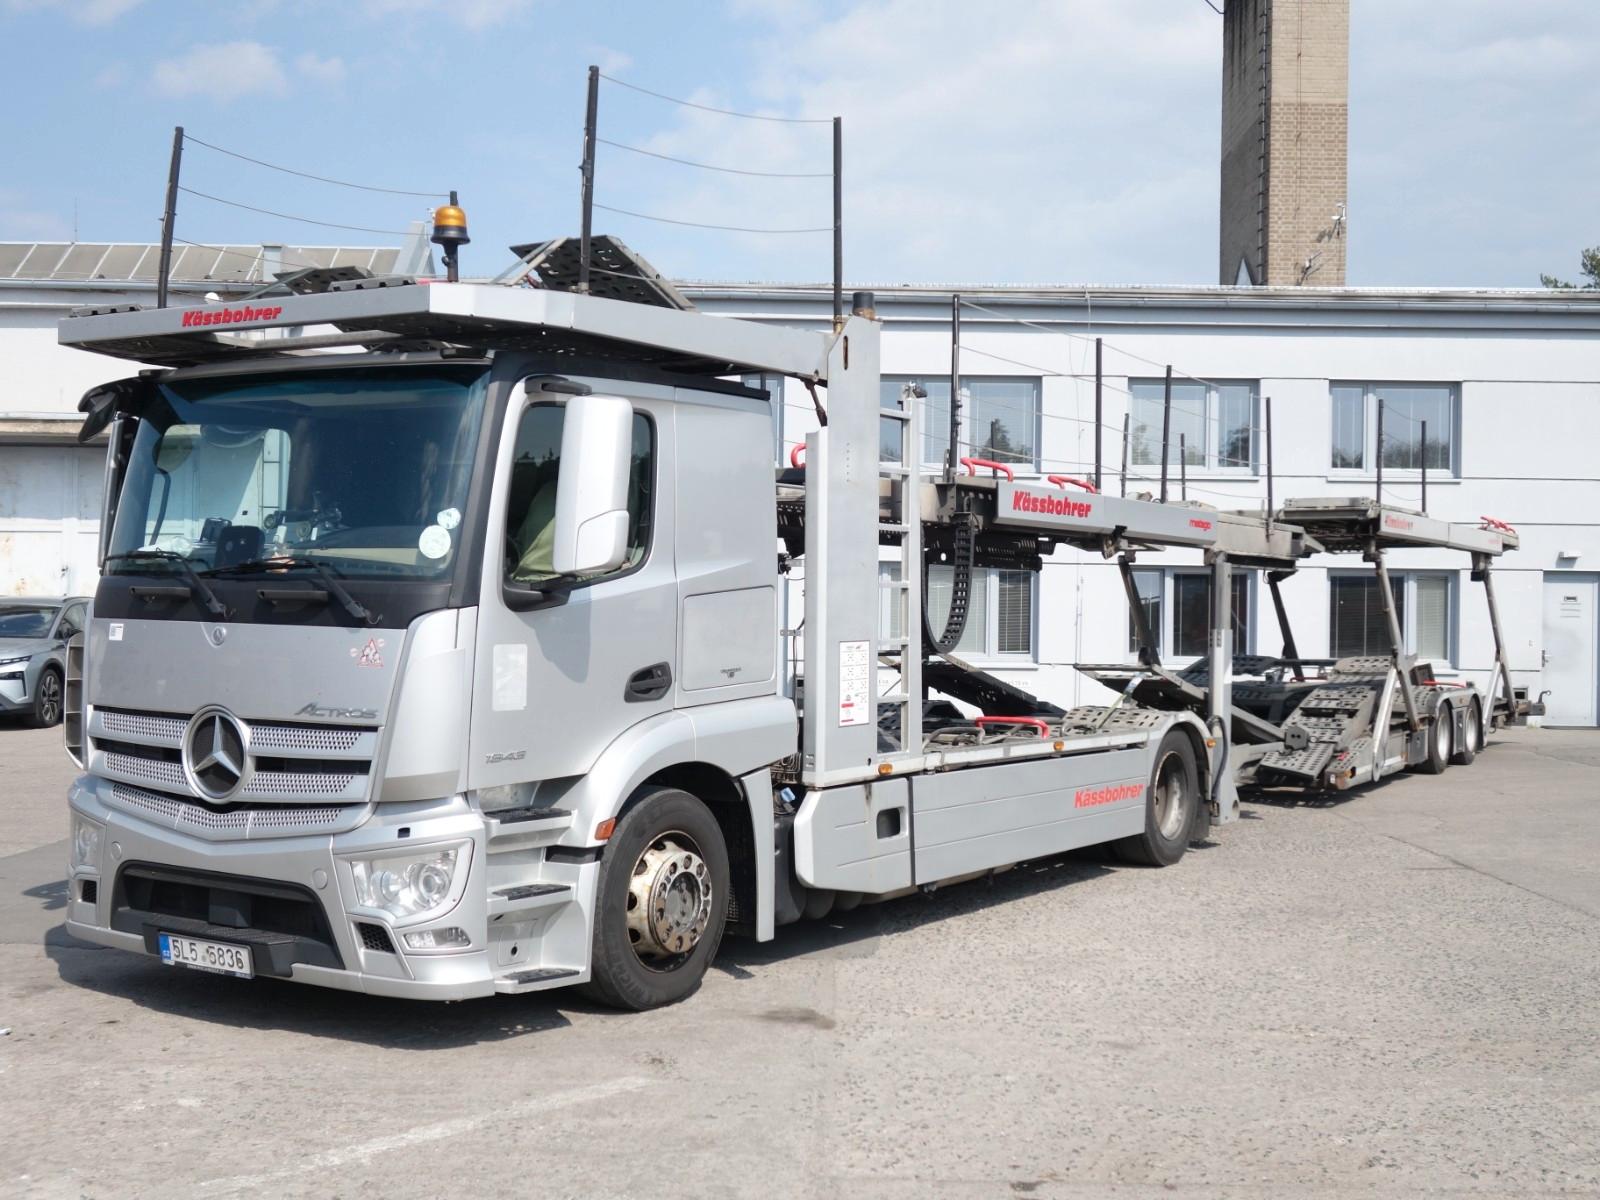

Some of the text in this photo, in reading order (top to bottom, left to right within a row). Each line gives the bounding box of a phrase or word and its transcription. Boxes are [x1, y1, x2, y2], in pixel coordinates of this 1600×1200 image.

[182, 305, 282, 327] Kässbohrer
[1012, 490, 1092, 518] Kässbohrer
[1074, 784, 1145, 808] Kässbohrer
[172, 939, 198, 961] 5L5
